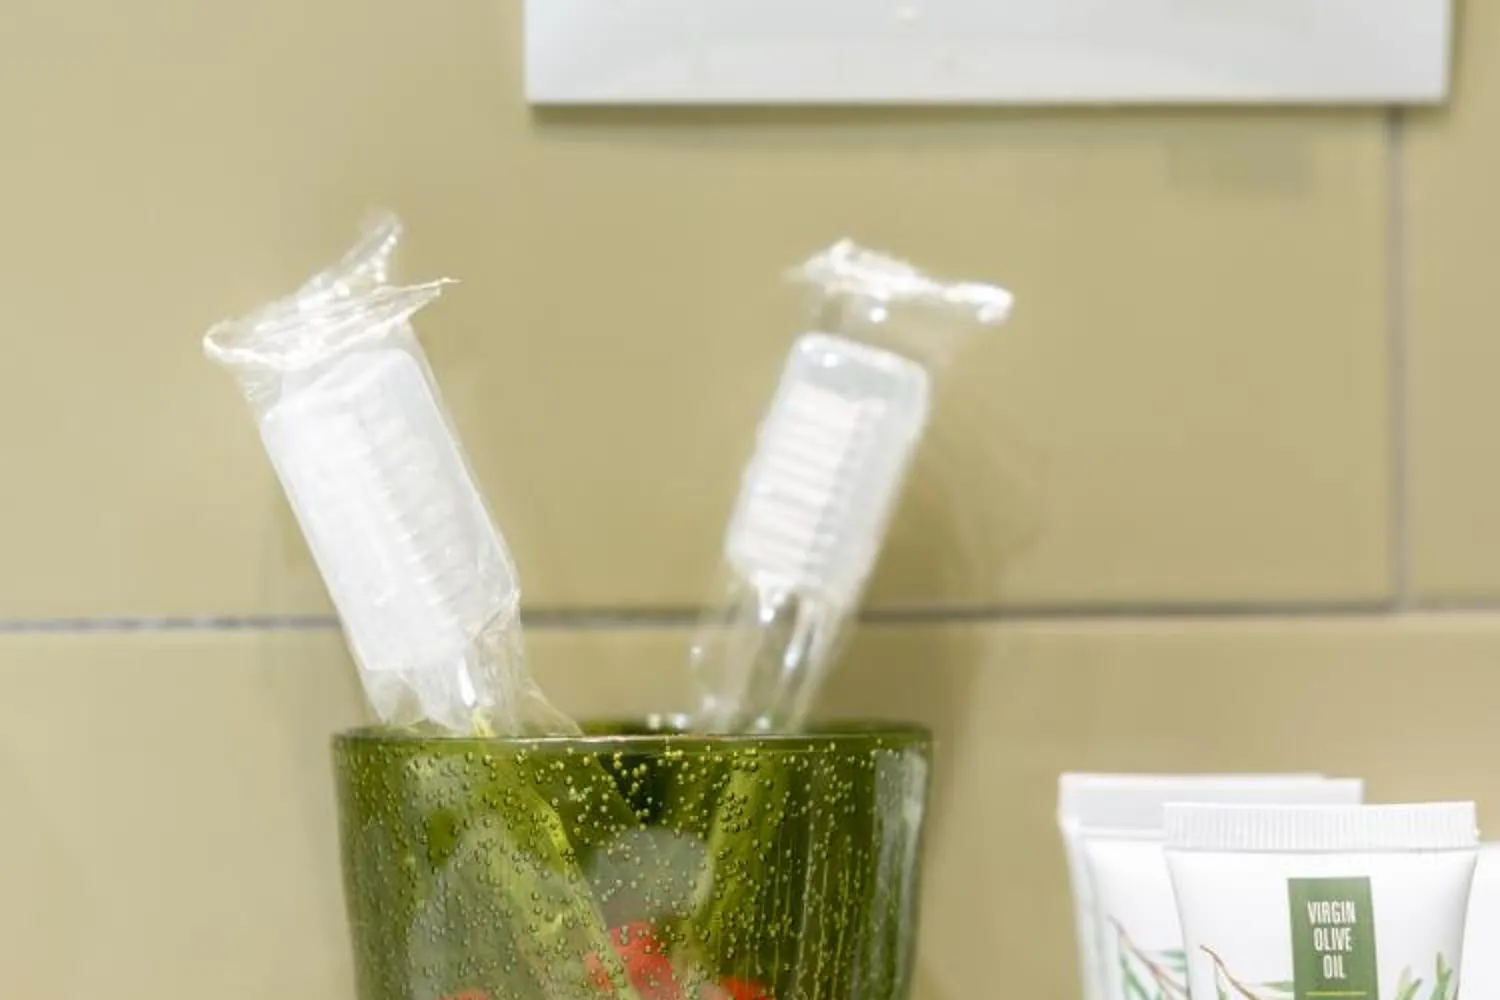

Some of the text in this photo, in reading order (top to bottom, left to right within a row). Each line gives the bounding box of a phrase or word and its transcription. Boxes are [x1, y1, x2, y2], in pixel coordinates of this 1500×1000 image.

[1306, 900, 1357, 925] VIRGIN
[1313, 927, 1353, 952] OLIVE
[1322, 955, 1347, 980] OIL
